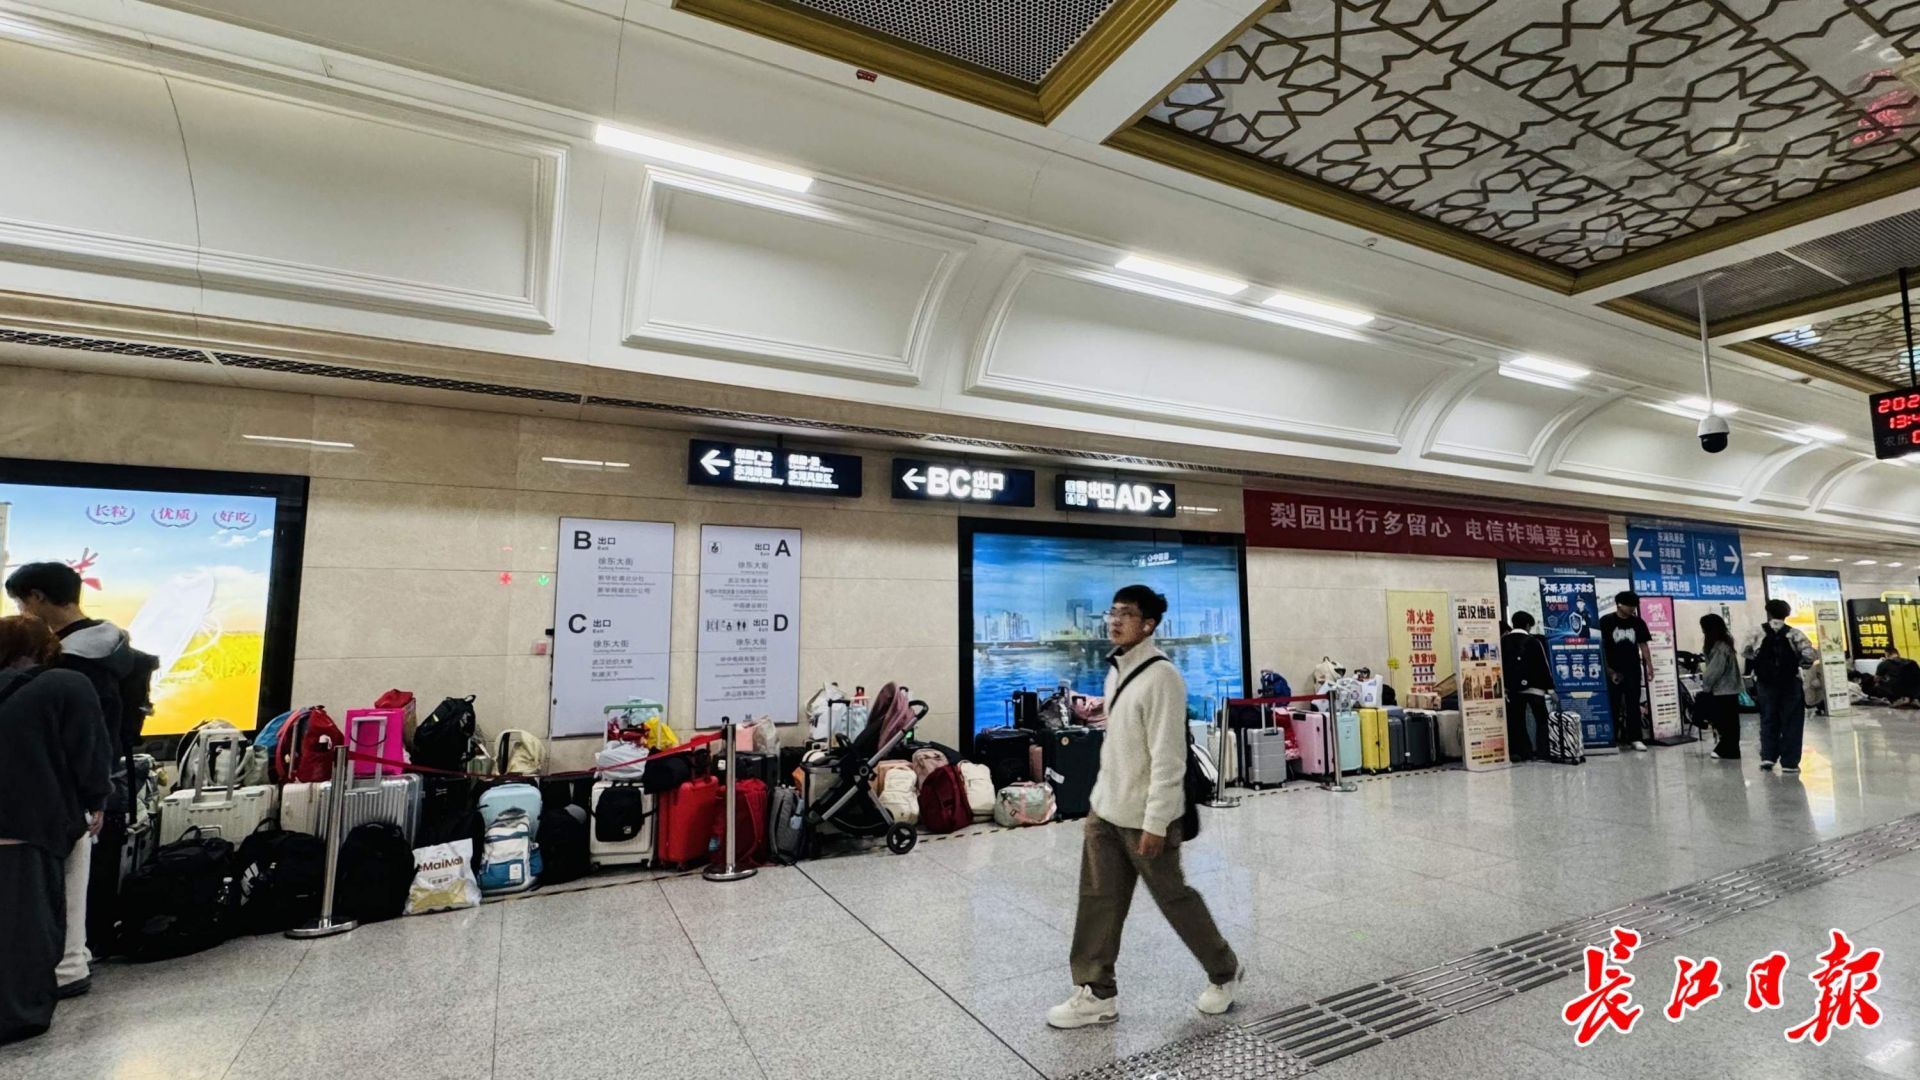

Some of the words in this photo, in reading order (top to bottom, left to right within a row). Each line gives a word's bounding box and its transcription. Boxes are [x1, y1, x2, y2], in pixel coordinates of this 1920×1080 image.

[928, 467, 970, 497] BC
[973, 471, 1003, 490] 出口
[1088, 481, 1115, 499] 出口
[1115, 484, 1152, 511] AD
[95, 504, 128, 518] 长粒
[159, 507, 191, 521] 优质
[219, 510, 251, 524] 好吃
[1270, 502, 1451, 539] 梨园出行多留心
[1465, 518, 1597, 550] 电信诈骗要当心
[574, 530, 592, 550] B
[598, 537, 616, 545] 出口
[754, 543, 770, 551] 出口
[774, 539, 791, 557] A
[1699, 558, 1718, 571] 卫生间
[1406, 608, 1434, 624] 消火栓
[1457, 605, 1496, 619] 武汉地标
[568, 614, 587, 634] C
[592, 619, 612, 628] 出口
[753, 619, 768, 627] 出口
[774, 614, 788, 632] D
[1858, 624, 1887, 634] 自助
[1860, 636, 1889, 648] 寄存
